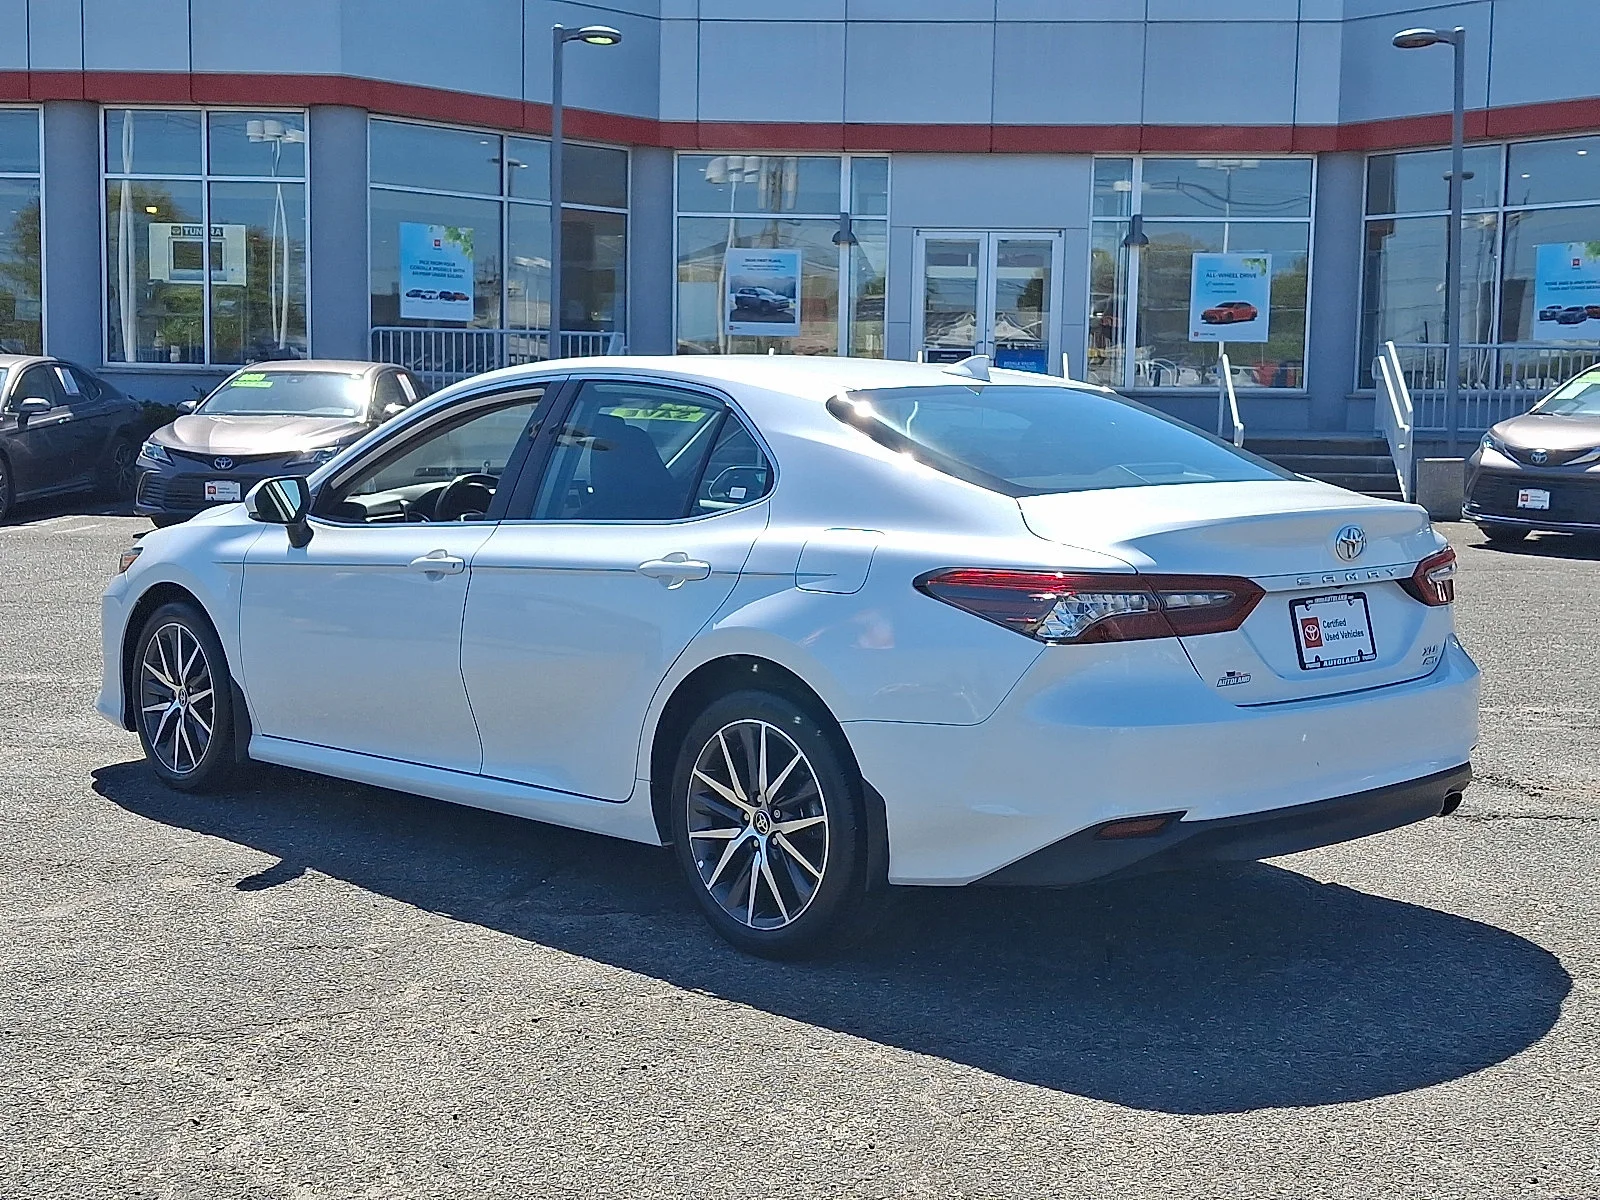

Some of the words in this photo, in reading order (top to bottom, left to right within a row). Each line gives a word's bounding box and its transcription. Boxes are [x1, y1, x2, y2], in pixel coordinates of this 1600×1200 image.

[183, 227, 222, 236] TUNRA
[1297, 567, 1396, 586] CAMRY
[1322, 618, 1347, 628] Certified
[1325, 632, 1340, 641] Used
[1340, 629, 1364, 640] Vehicles
[1323, 655, 1360, 667] AUTOLAND
